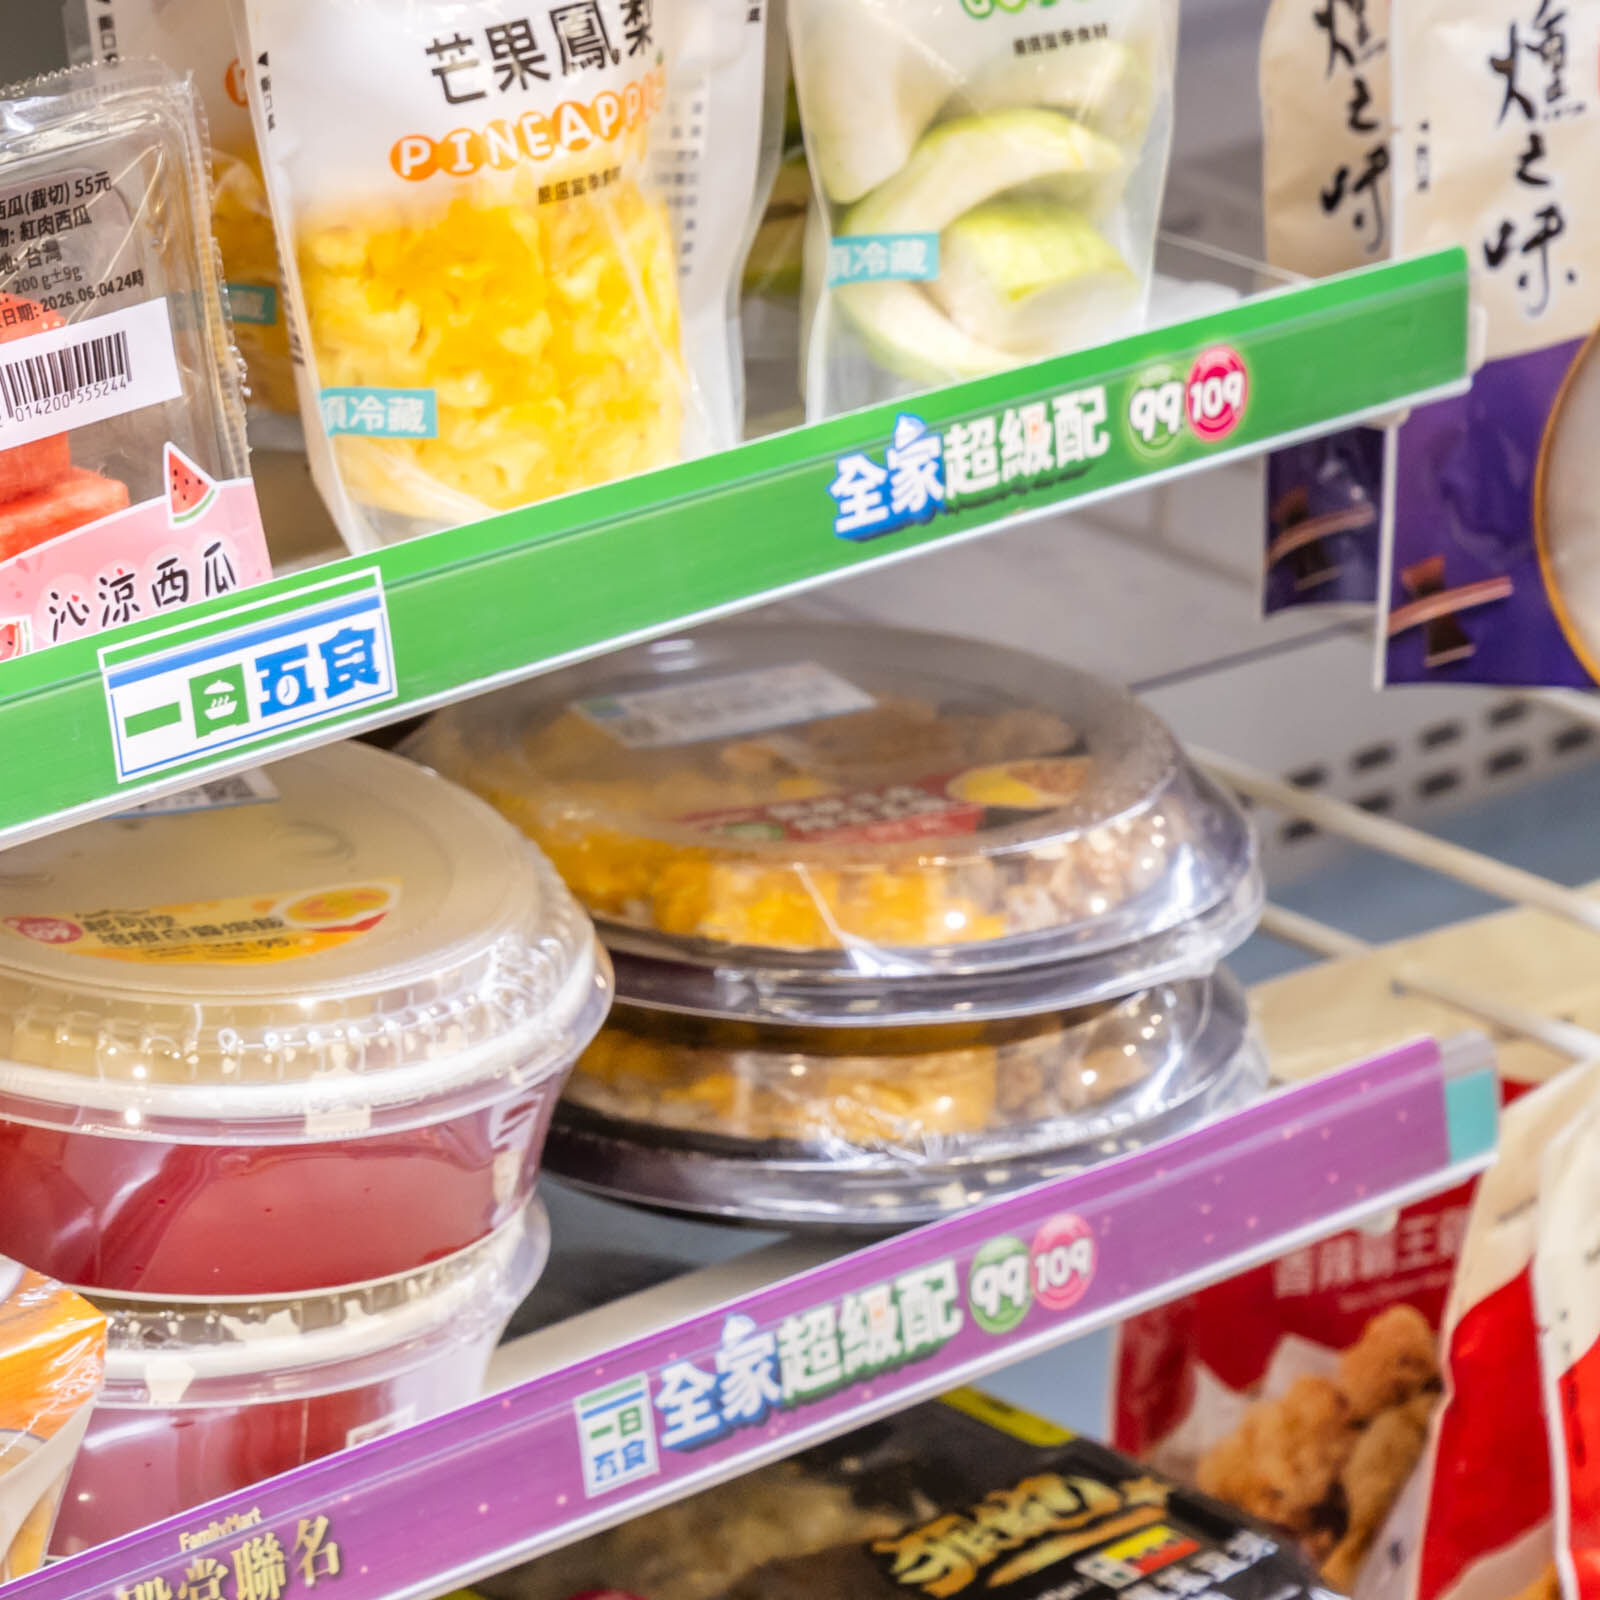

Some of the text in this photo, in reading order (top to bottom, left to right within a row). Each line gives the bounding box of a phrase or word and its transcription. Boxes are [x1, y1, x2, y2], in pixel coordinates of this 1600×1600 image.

[393, 69, 665, 179] PINEAPP
[75, 171, 113, 198] 55元
[20, 204, 92, 242] 紅肉西瓜
[27, 240, 63, 270] 台灣
[14, 277, 38, 294] 200
[42, 266, 83, 291] g±9g
[41, 283, 115, 312] 2026.06.04
[115, 269, 144, 291] 24時
[15, 396, 70, 423] 014200
[76, 378, 128, 405] 555244
[1130, 371, 1244, 441] 99 109
[830, 385, 1110, 534] 全家超級配
[46, 541, 239, 642] 沁涼西瓜
[123, 625, 381, 742] 一日五食
[971, 1240, 1091, 1314] 99 109
[655, 1258, 964, 1434] 全家超級配
[589, 1404, 645, 1441] 一日
[178, 1505, 264, 1553] FamilyMart
